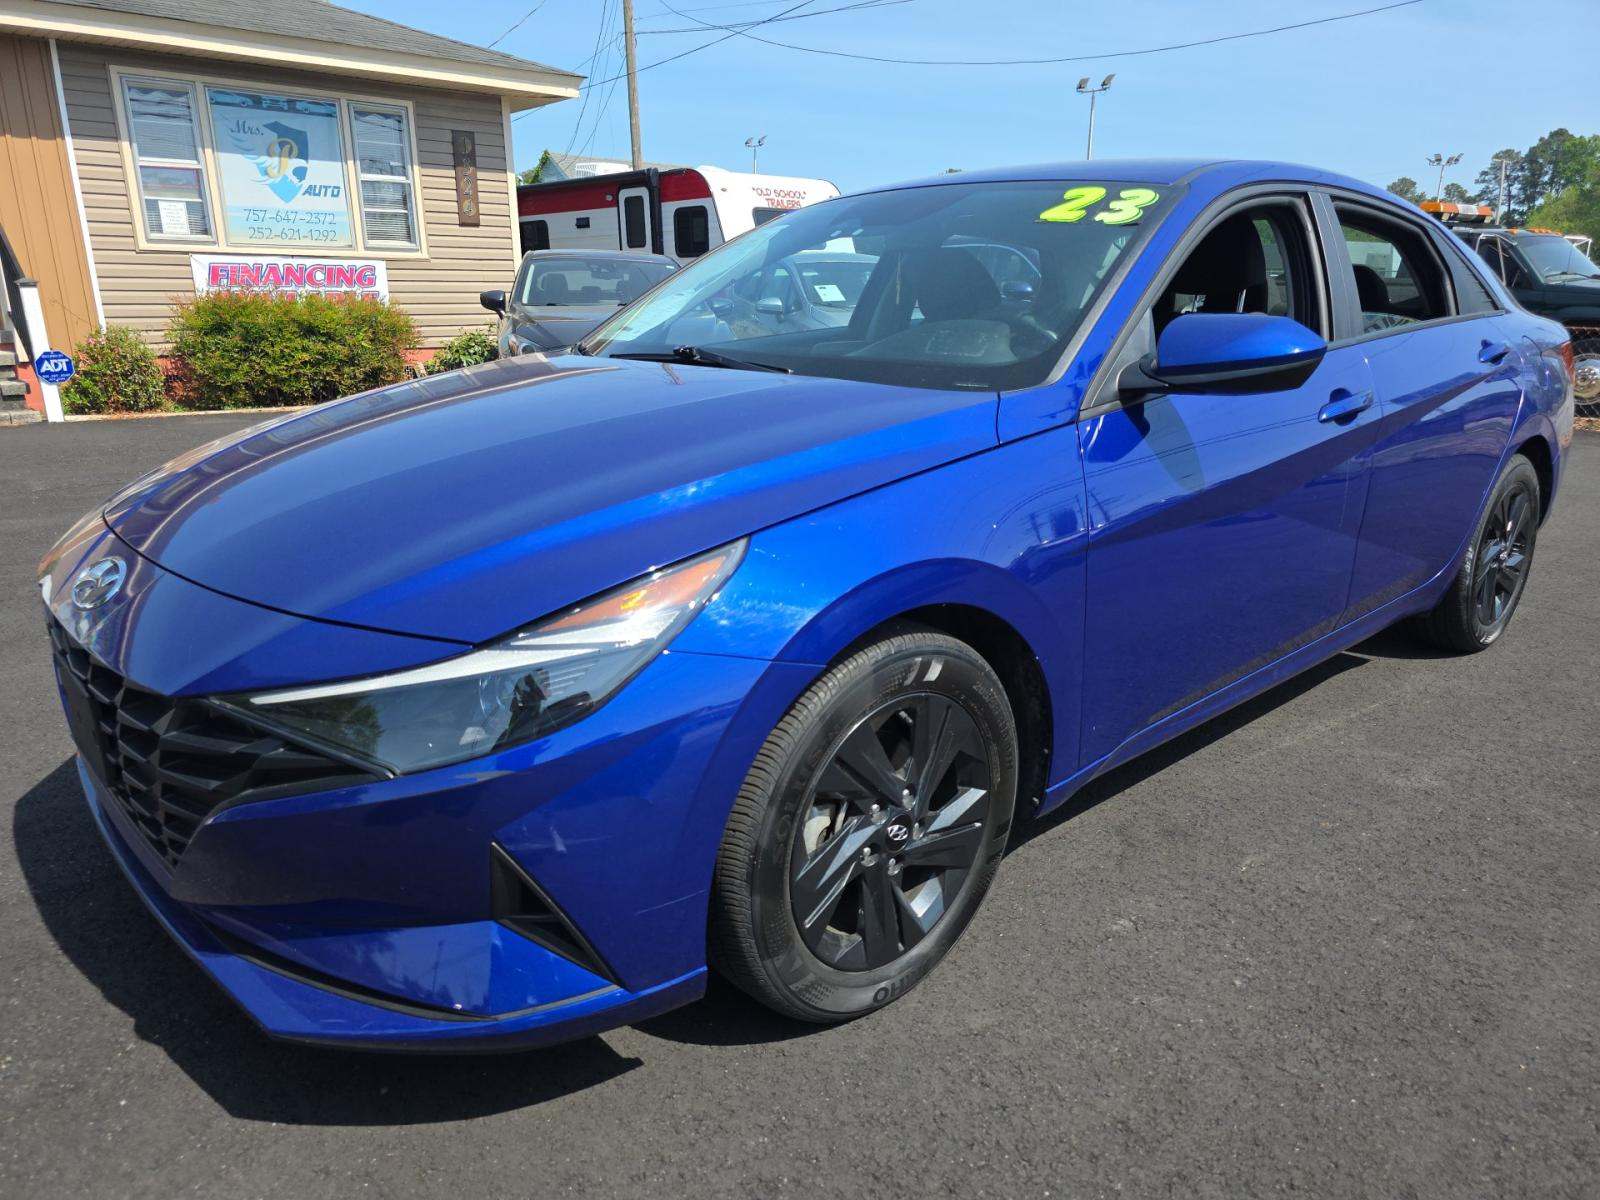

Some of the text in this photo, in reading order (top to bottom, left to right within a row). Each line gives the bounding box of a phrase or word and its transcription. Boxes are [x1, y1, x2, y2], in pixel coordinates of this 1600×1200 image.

[230, 118, 265, 137] Mrs.
[302, 184, 341, 198] AUTO
[1039, 186, 1160, 225] 23
[243, 208, 337, 225] 757-647-2372
[248, 226, 338, 242] 252-621-1292
[208, 262, 378, 288] FINANCING
[40, 358, 69, 373] ADT
